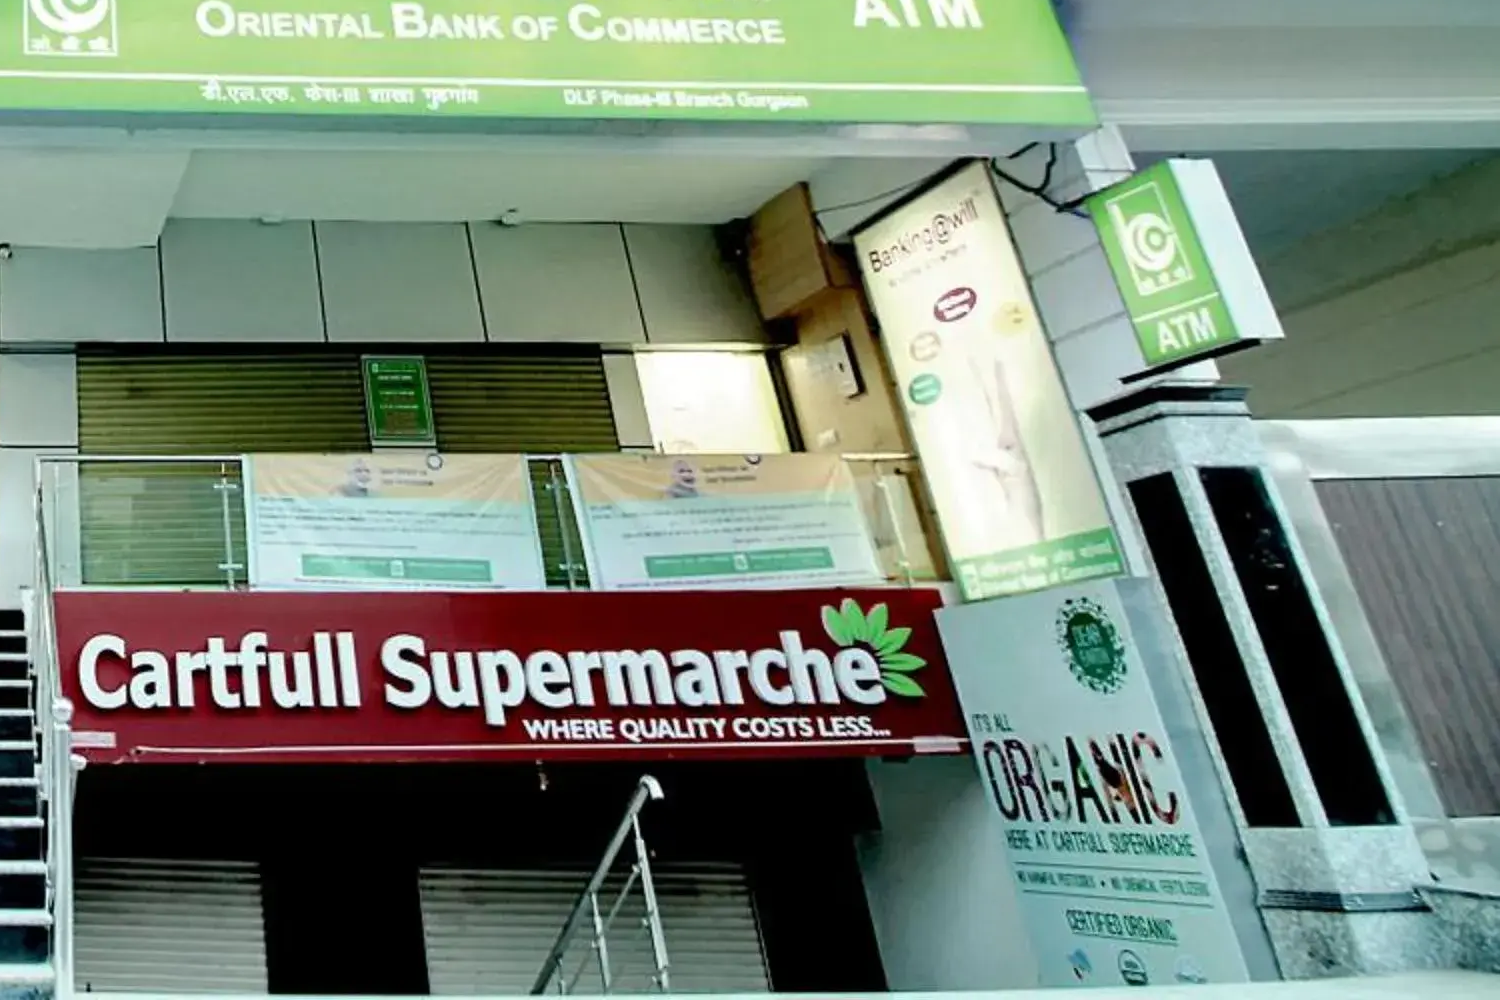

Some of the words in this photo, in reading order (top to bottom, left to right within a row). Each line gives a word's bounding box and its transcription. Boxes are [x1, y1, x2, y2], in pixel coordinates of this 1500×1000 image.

[195, 0, 384, 40] ORIENTAL
[391, 1, 505, 41] BANK
[566, 4, 786, 44] COMMERCE
[563, 88, 598, 106] DLF
[675, 91, 735, 109] Branch
[1156, 306, 1217, 354] ATM
[78, 631, 361, 710] Cartfull
[380, 630, 886, 727] Supermarche
[522, 718, 615, 741] WHERE
[619, 718, 726, 743] QUALITY
[732, 717, 813, 740] COSTS
[818, 715, 891, 738] LESS...
[982, 731, 1181, 825] ORGANIC
[1034, 829, 1051, 850] AT
